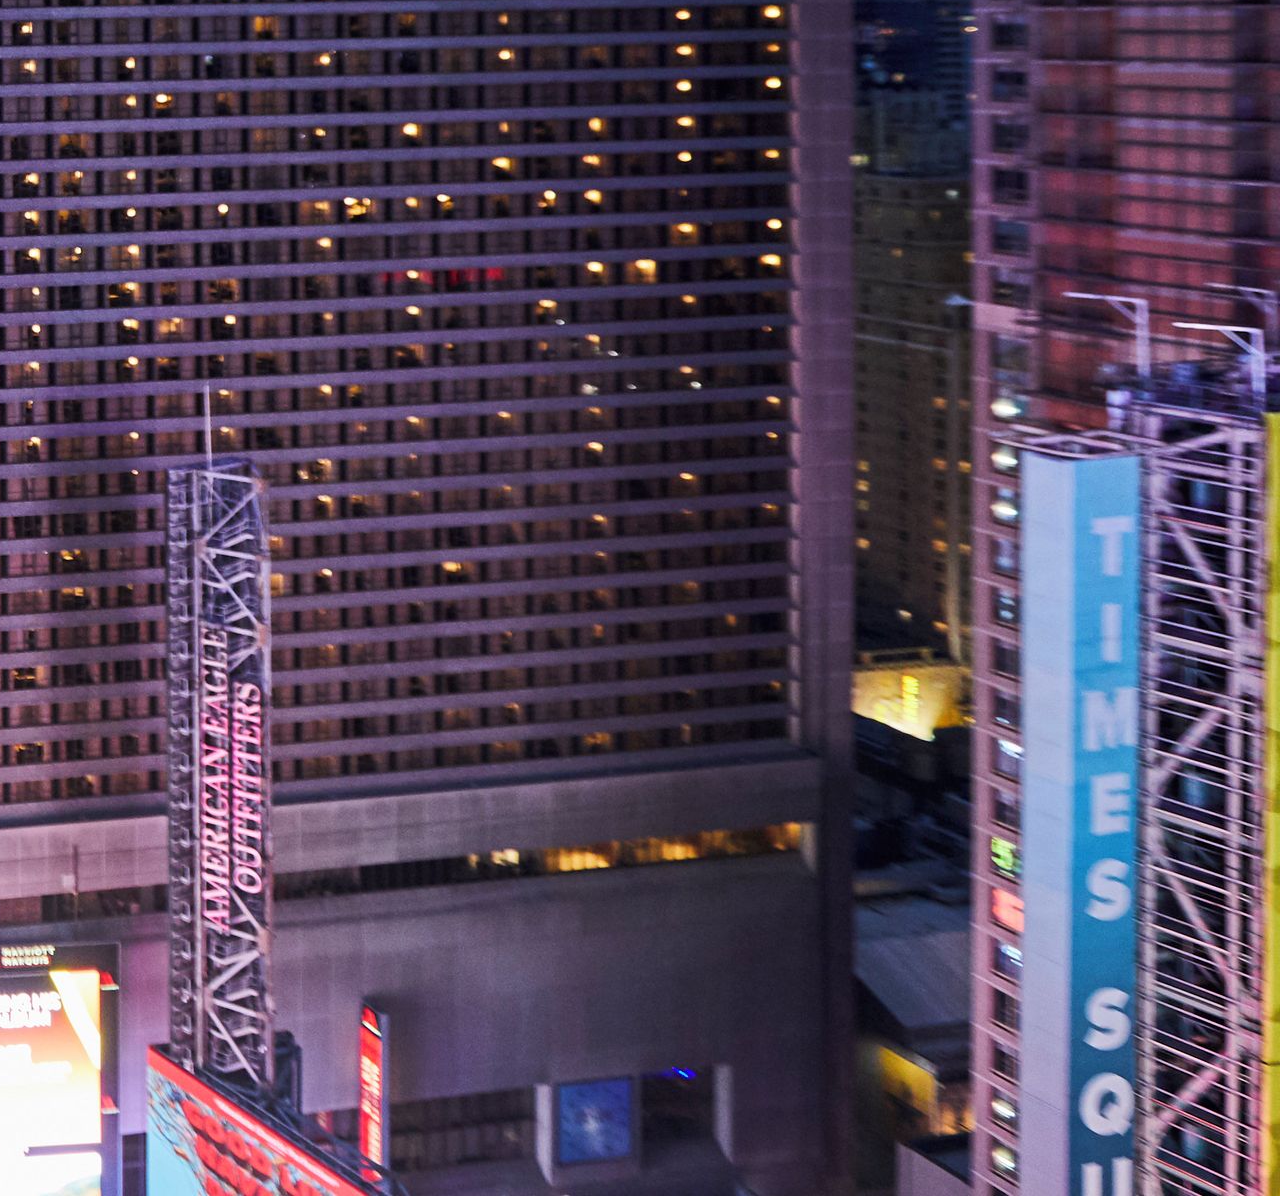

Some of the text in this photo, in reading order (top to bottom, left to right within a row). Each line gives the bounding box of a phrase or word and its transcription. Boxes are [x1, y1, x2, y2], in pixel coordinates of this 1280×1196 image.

[201, 625, 230, 935] AMERICAN EAGLE
[232, 680, 264, 895] OUTFITTERS
[1081, 515, 1137, 922] TIMES
[0, 945, 56, 958] MARRIOTT
[0, 955, 51, 967] MARQUIS
